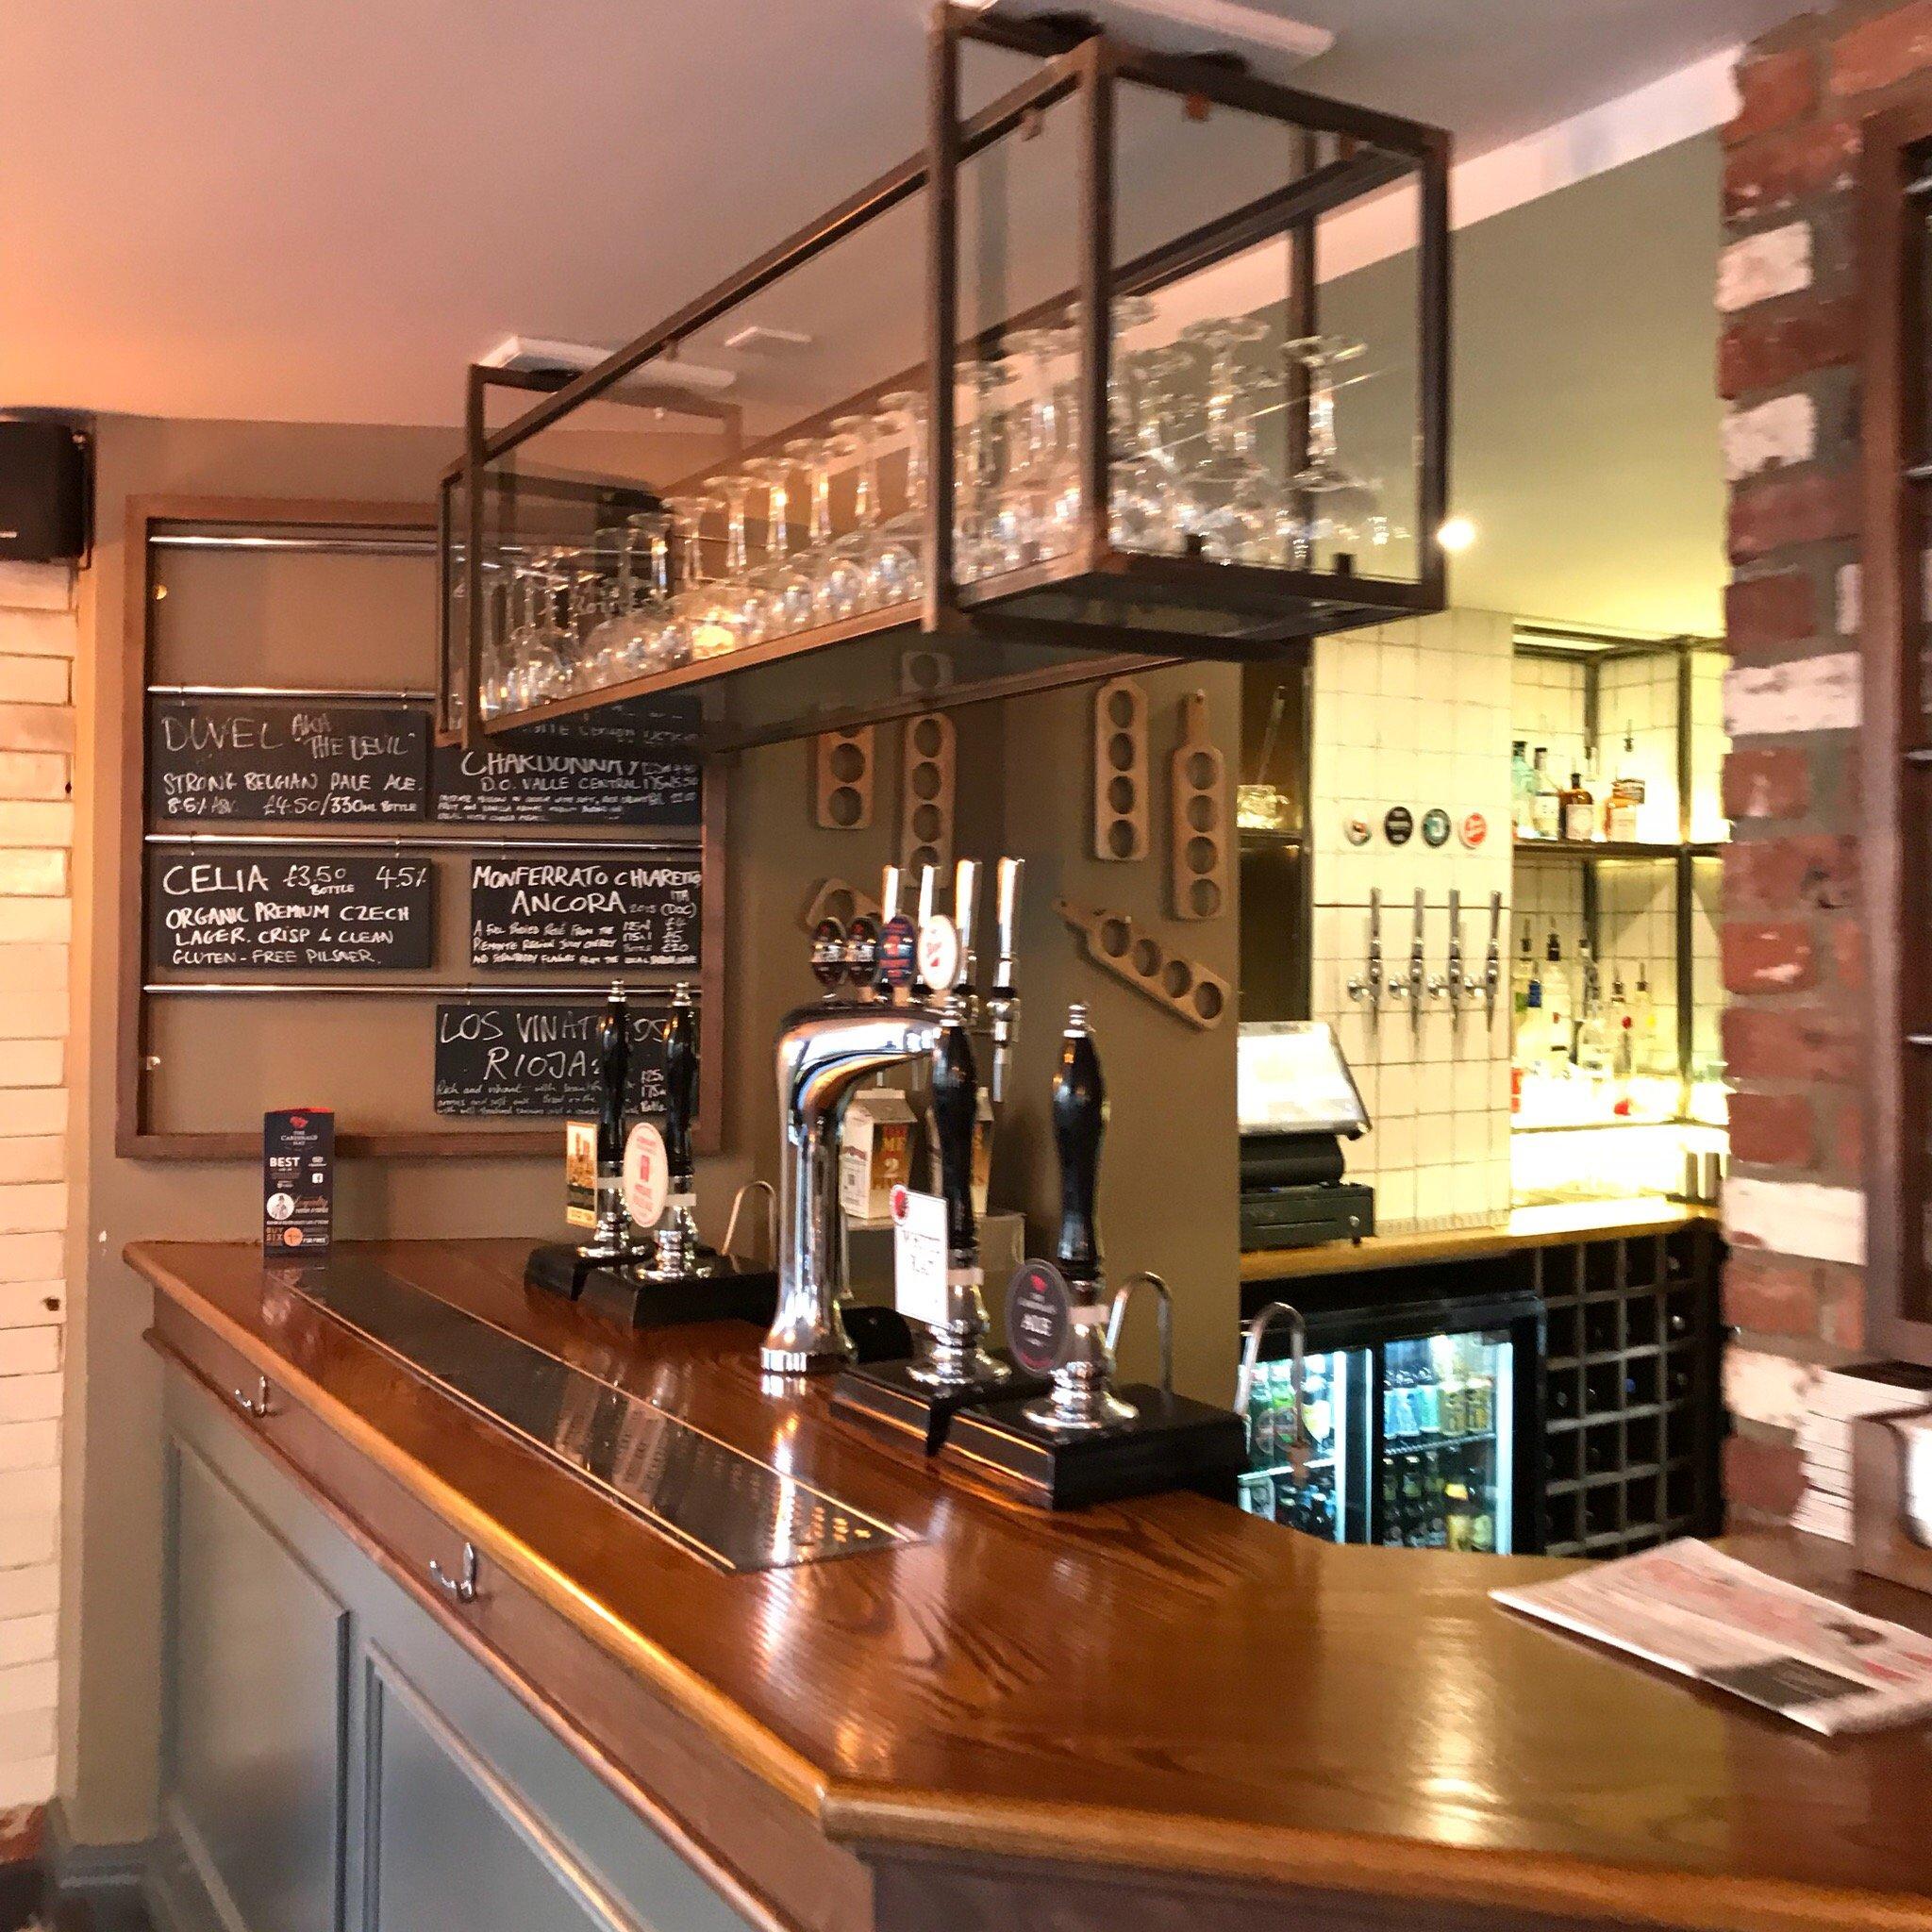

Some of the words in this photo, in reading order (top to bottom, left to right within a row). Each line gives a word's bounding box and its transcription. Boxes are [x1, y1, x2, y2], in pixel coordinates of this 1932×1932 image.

[161, 717, 283, 752] DUVEL
[460, 751, 641, 776] CHARDONNAY
[163, 772, 237, 795] STRONG
[243, 772, 319, 792] BELGIAN
[330, 774, 371, 791] PALE
[522, 775, 570, 791] VALLE
[576, 776, 641, 791] CENTRAL
[161, 864, 270, 895] CELIA
[282, 864, 346, 888] £3.50
[308, 882, 355, 896] BOTTLE
[472, 864, 609, 890] MONFERRATO
[165, 906, 250, 930] ORGANIC
[254, 901, 330, 924] PREMIUM
[339, 905, 409, 922] CZECH
[510, 890, 627, 917] ANCORA
[257, 926, 310, 944] CRISP
[318, 929, 332, 942] &
[337, 929, 395, 944] CLEAN
[441, 1010, 504, 1043] LOS
[462, 1084, 483, 1094] and
[269, 1157, 301, 1168] BEST
